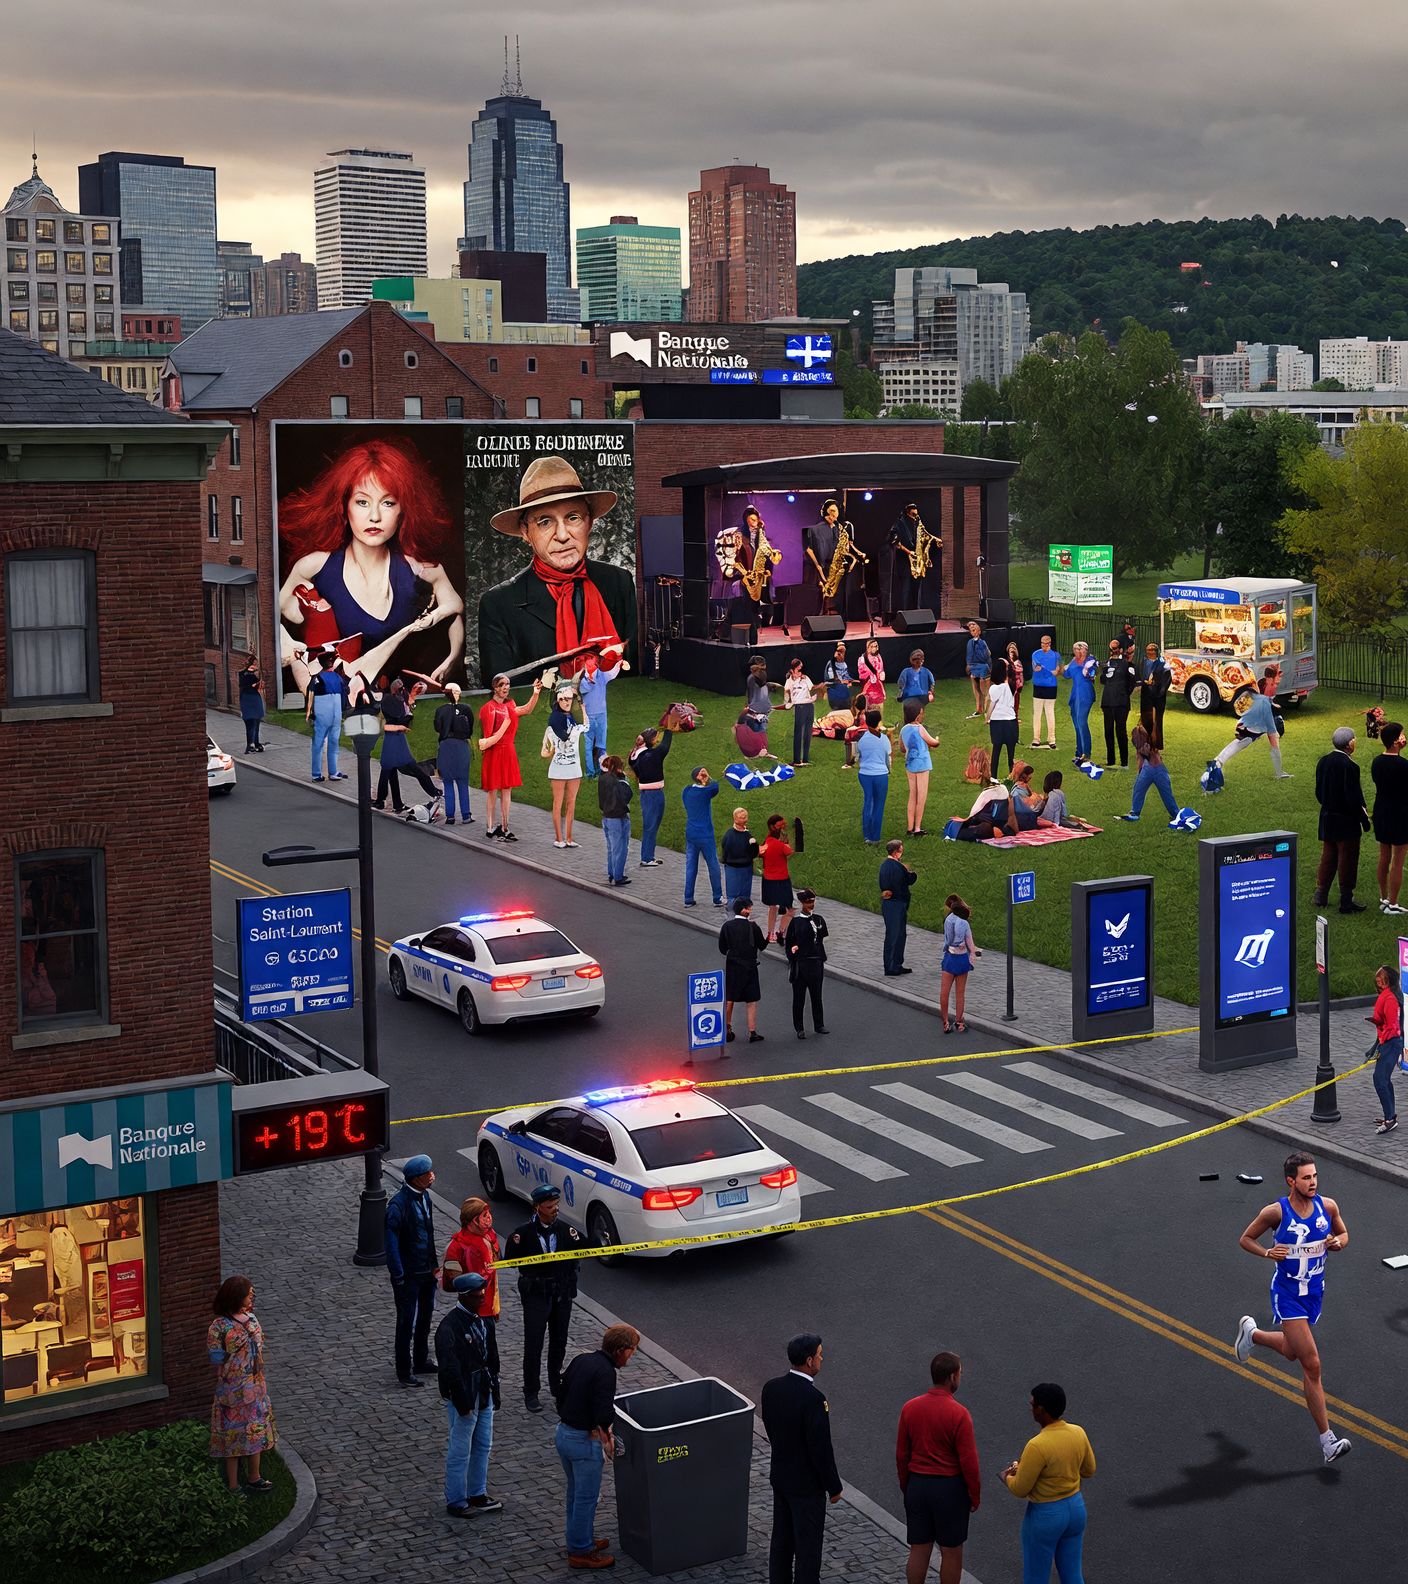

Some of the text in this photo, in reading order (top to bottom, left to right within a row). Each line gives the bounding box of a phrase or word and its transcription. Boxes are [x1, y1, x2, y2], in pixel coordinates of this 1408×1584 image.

[262, 905, 313, 921] Station
[120, 1122, 195, 1145] Banque
[120, 1137, 207, 1164] Nationale
